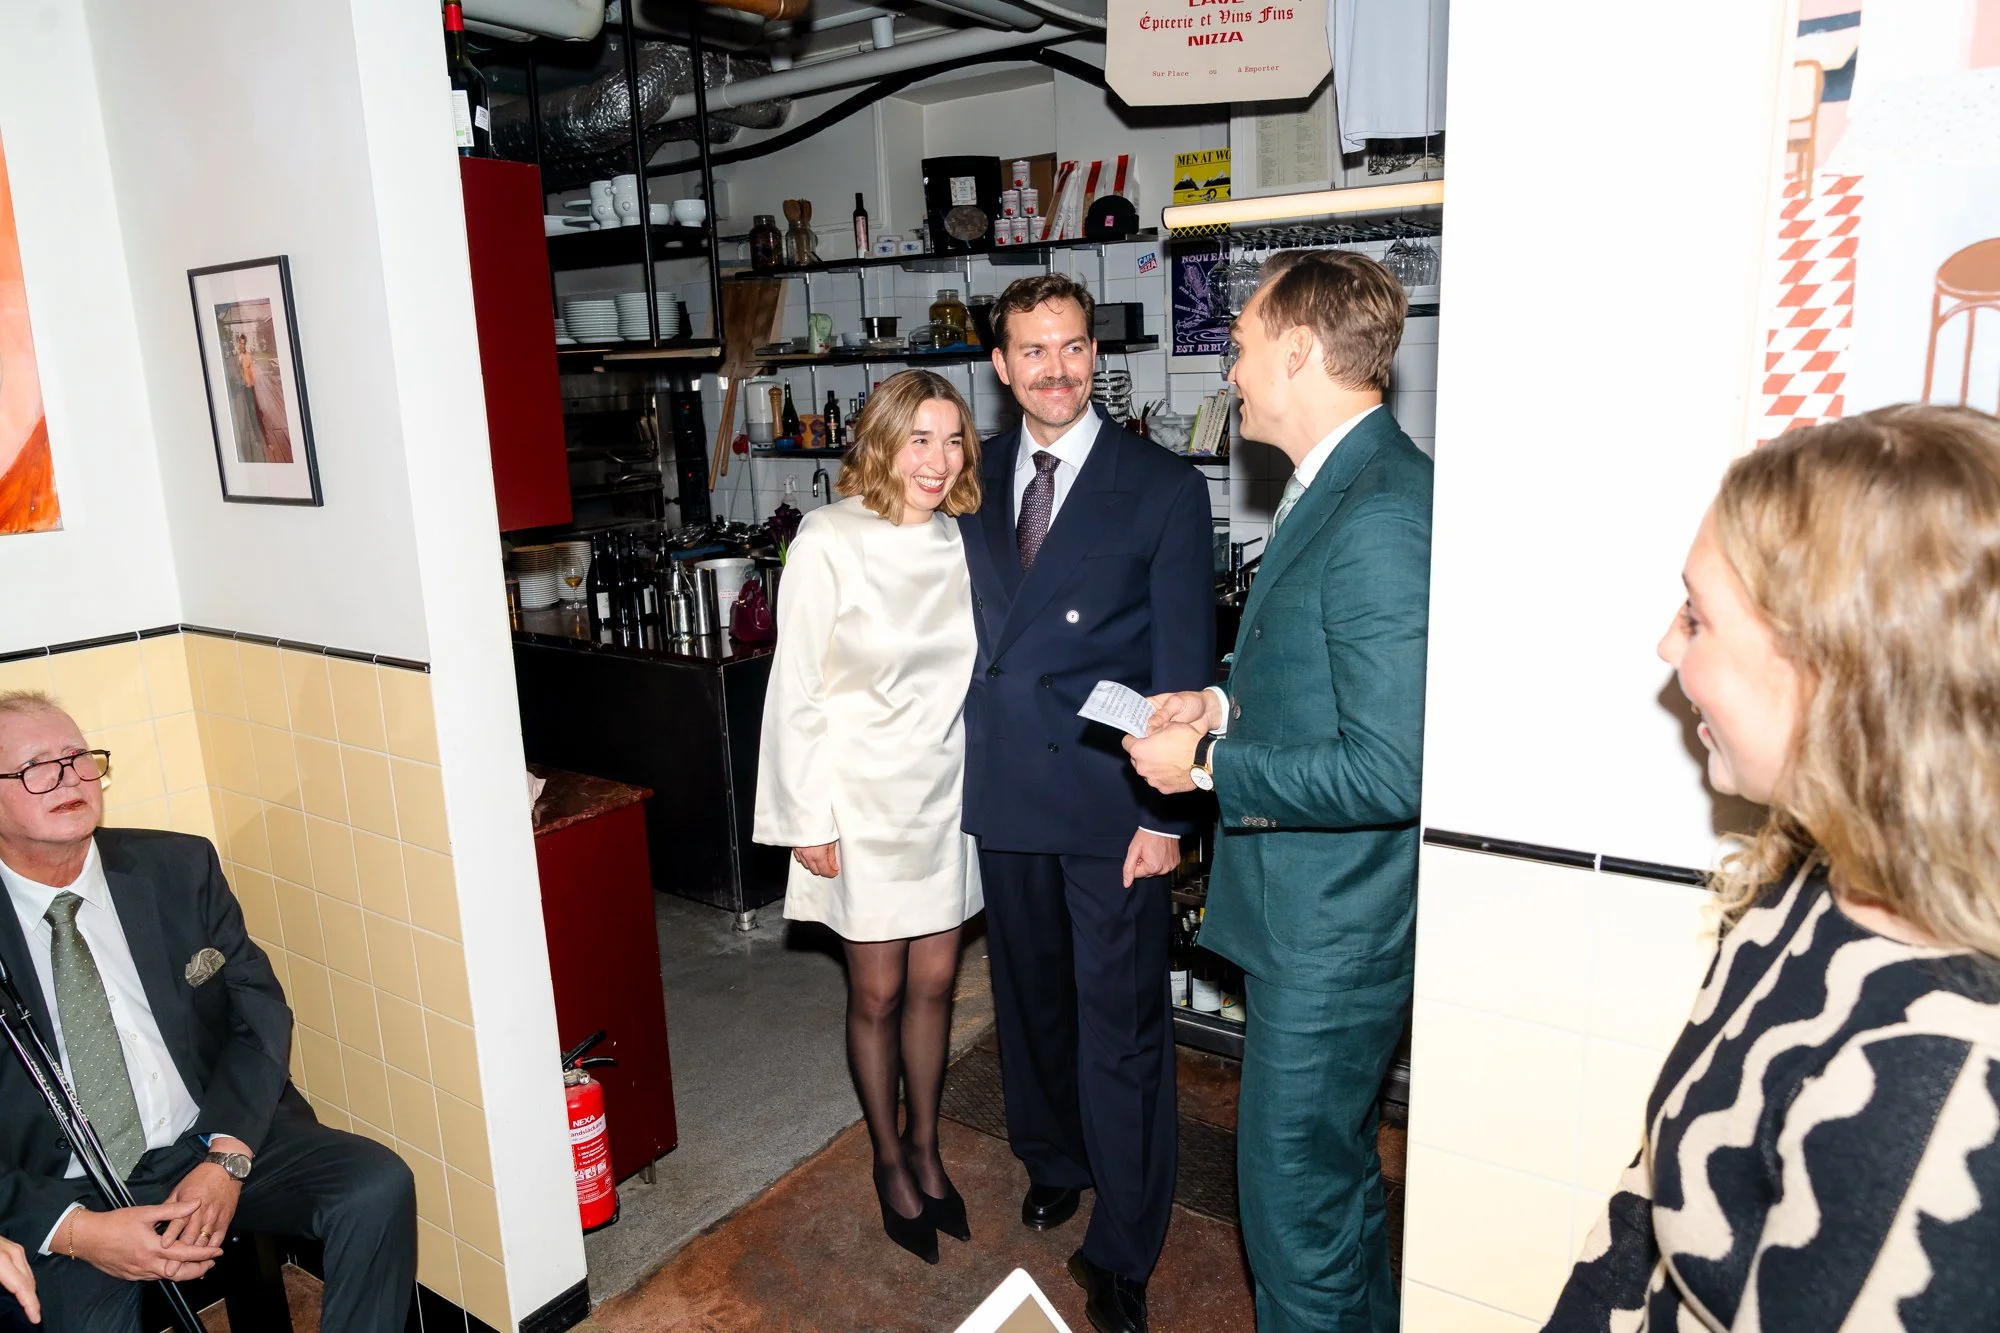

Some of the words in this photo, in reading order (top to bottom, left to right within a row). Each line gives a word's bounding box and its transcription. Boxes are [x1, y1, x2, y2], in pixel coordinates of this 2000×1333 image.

[1139, 11, 1194, 31] Épicerie
[1200, 14, 1212, 27] et
[1219, 9, 1253, 25] Vins
[1257, 6, 1294, 24] Fins
[1188, 31, 1244, 47] NIZZA
[1244, 64, 1280, 73] Emporter
[1177, 153, 1199, 166] MEN
[1200, 151, 1214, 164] AT
[1181, 252, 1231, 264] NOUVEAU
[1175, 345, 1195, 354] EST
[31, 1061, 69, 1121] PRO-TOUCH
[53, 1062, 90, 1122] PRO-TOUCH
[572, 1114, 597, 1129] NEXA
